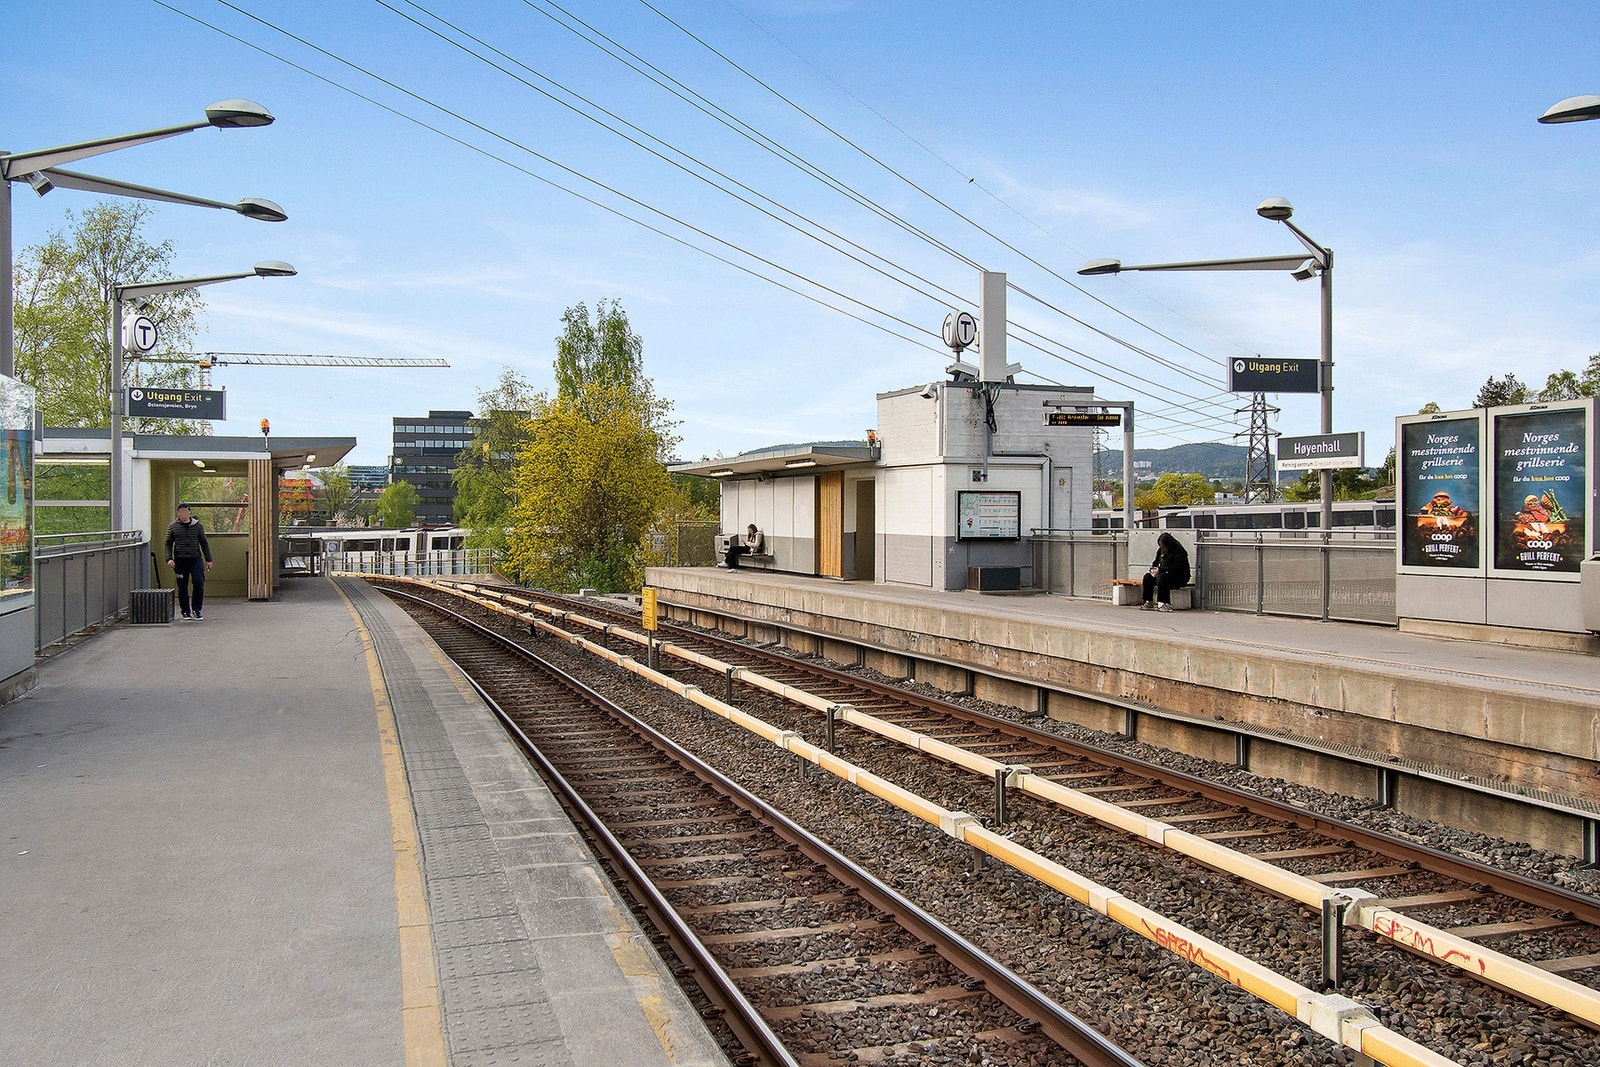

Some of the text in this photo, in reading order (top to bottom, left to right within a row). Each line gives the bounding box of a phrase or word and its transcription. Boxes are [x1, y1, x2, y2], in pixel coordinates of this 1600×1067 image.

[139, 325, 151, 346] T
[961, 320, 971, 340] T
[1249, 361, 1299, 374] Utgang Exit
[147, 391, 202, 403] Utgang Exit
[1427, 434, 1459, 445] Norges
[1522, 432, 1560, 445] Norges
[1294, 440, 1340, 456] Høyenhall
[1411, 443, 1475, 456] mestvinnende
[1504, 442, 1579, 456] mestvinnende
[1421, 456, 1464, 470] grillserie
[1515, 456, 1566, 472] grillserie
[1431, 533, 1453, 543] coop
[1425, 544, 1438, 553] GRILL
[1527, 540, 1553, 550] coop
[1520, 552, 1560, 562] GRILL PERFEKT
